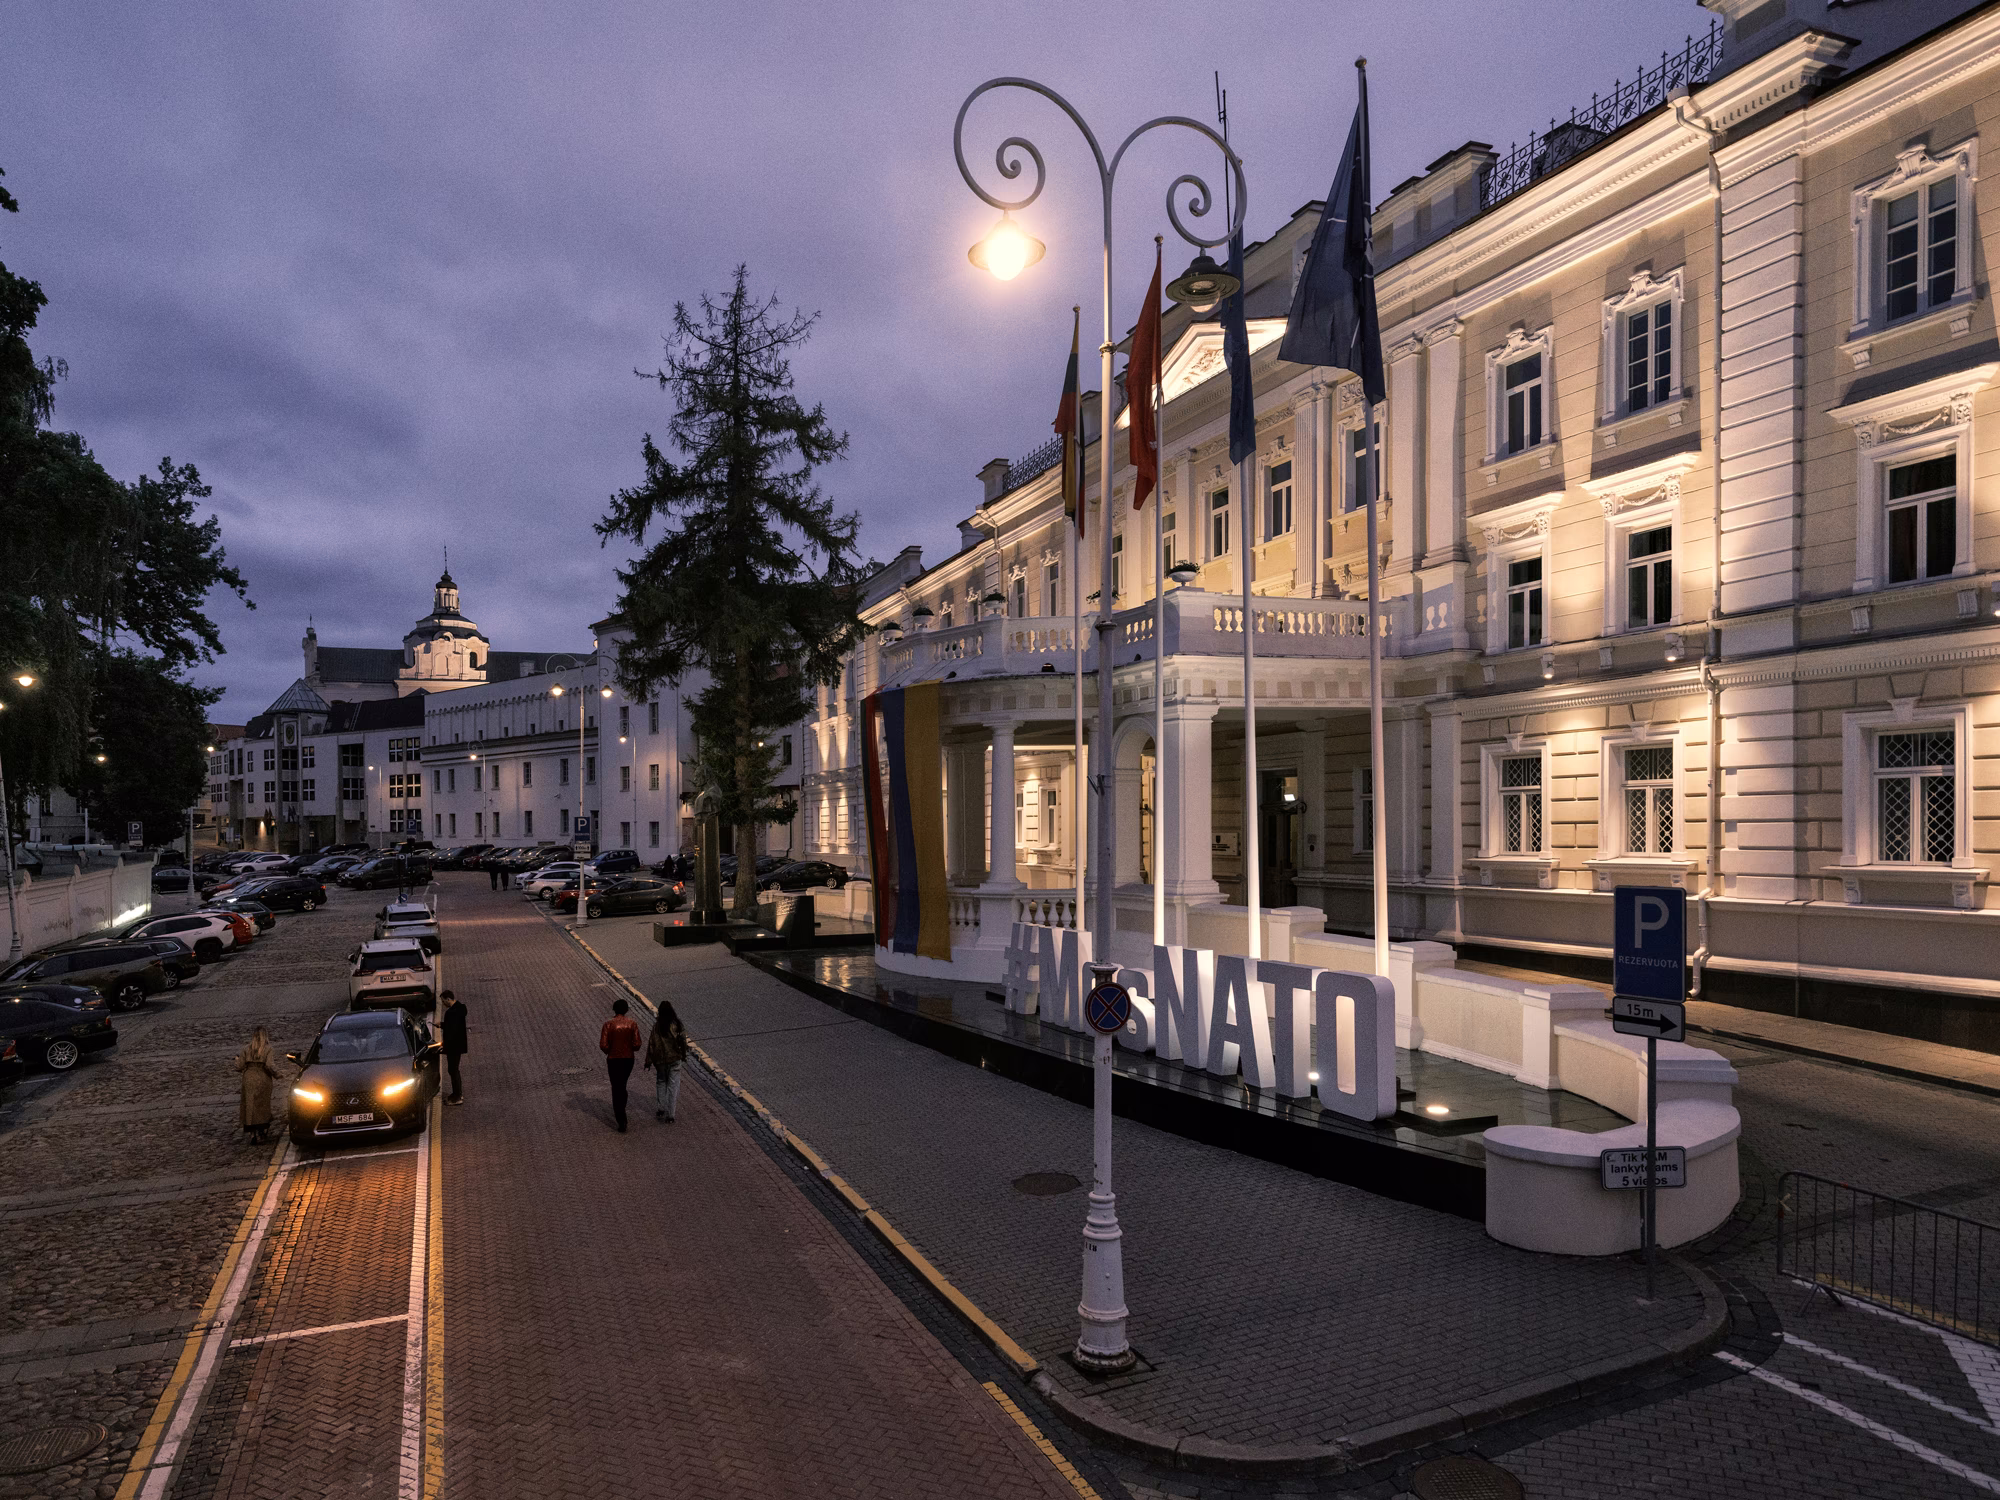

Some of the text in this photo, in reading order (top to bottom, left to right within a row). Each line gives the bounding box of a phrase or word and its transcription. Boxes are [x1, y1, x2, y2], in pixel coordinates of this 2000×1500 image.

[132, 823, 140, 833] P
[408, 820, 415, 829] P
[578, 818, 587, 831] P
[1635, 896, 1669, 948] P
[1618, 955, 1679, 968] REZERVUOTA
[337, 1113, 372, 1123] MSF 684
[1621, 1153, 1637, 1162] Tik
[1641, 1152, 1667, 1162] KM
[1622, 1176, 1668, 1186] 5 vieos
